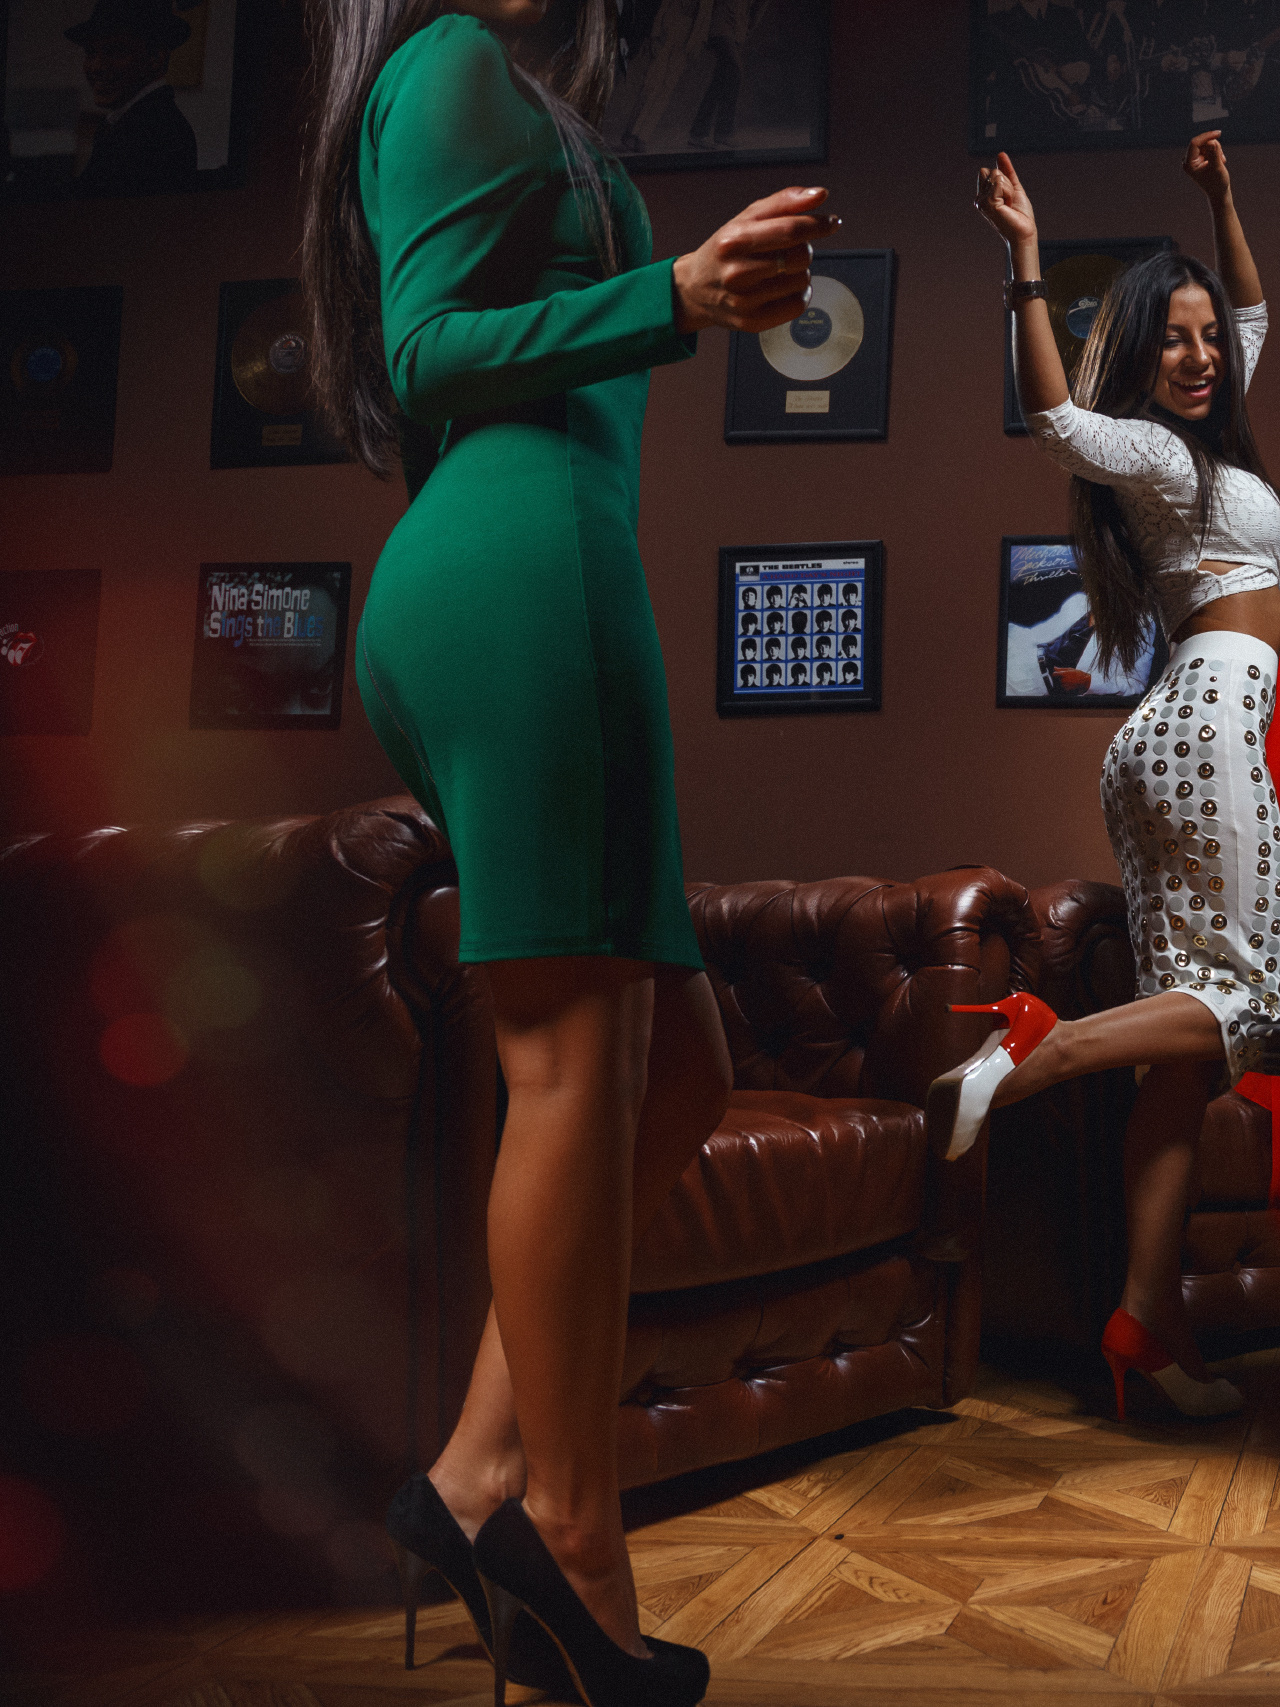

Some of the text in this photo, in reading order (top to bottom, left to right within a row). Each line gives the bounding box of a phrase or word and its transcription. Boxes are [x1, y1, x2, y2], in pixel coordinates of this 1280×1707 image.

[211, 583, 311, 611] Nina Simone
[209, 611, 324, 647] Sings the Blues
